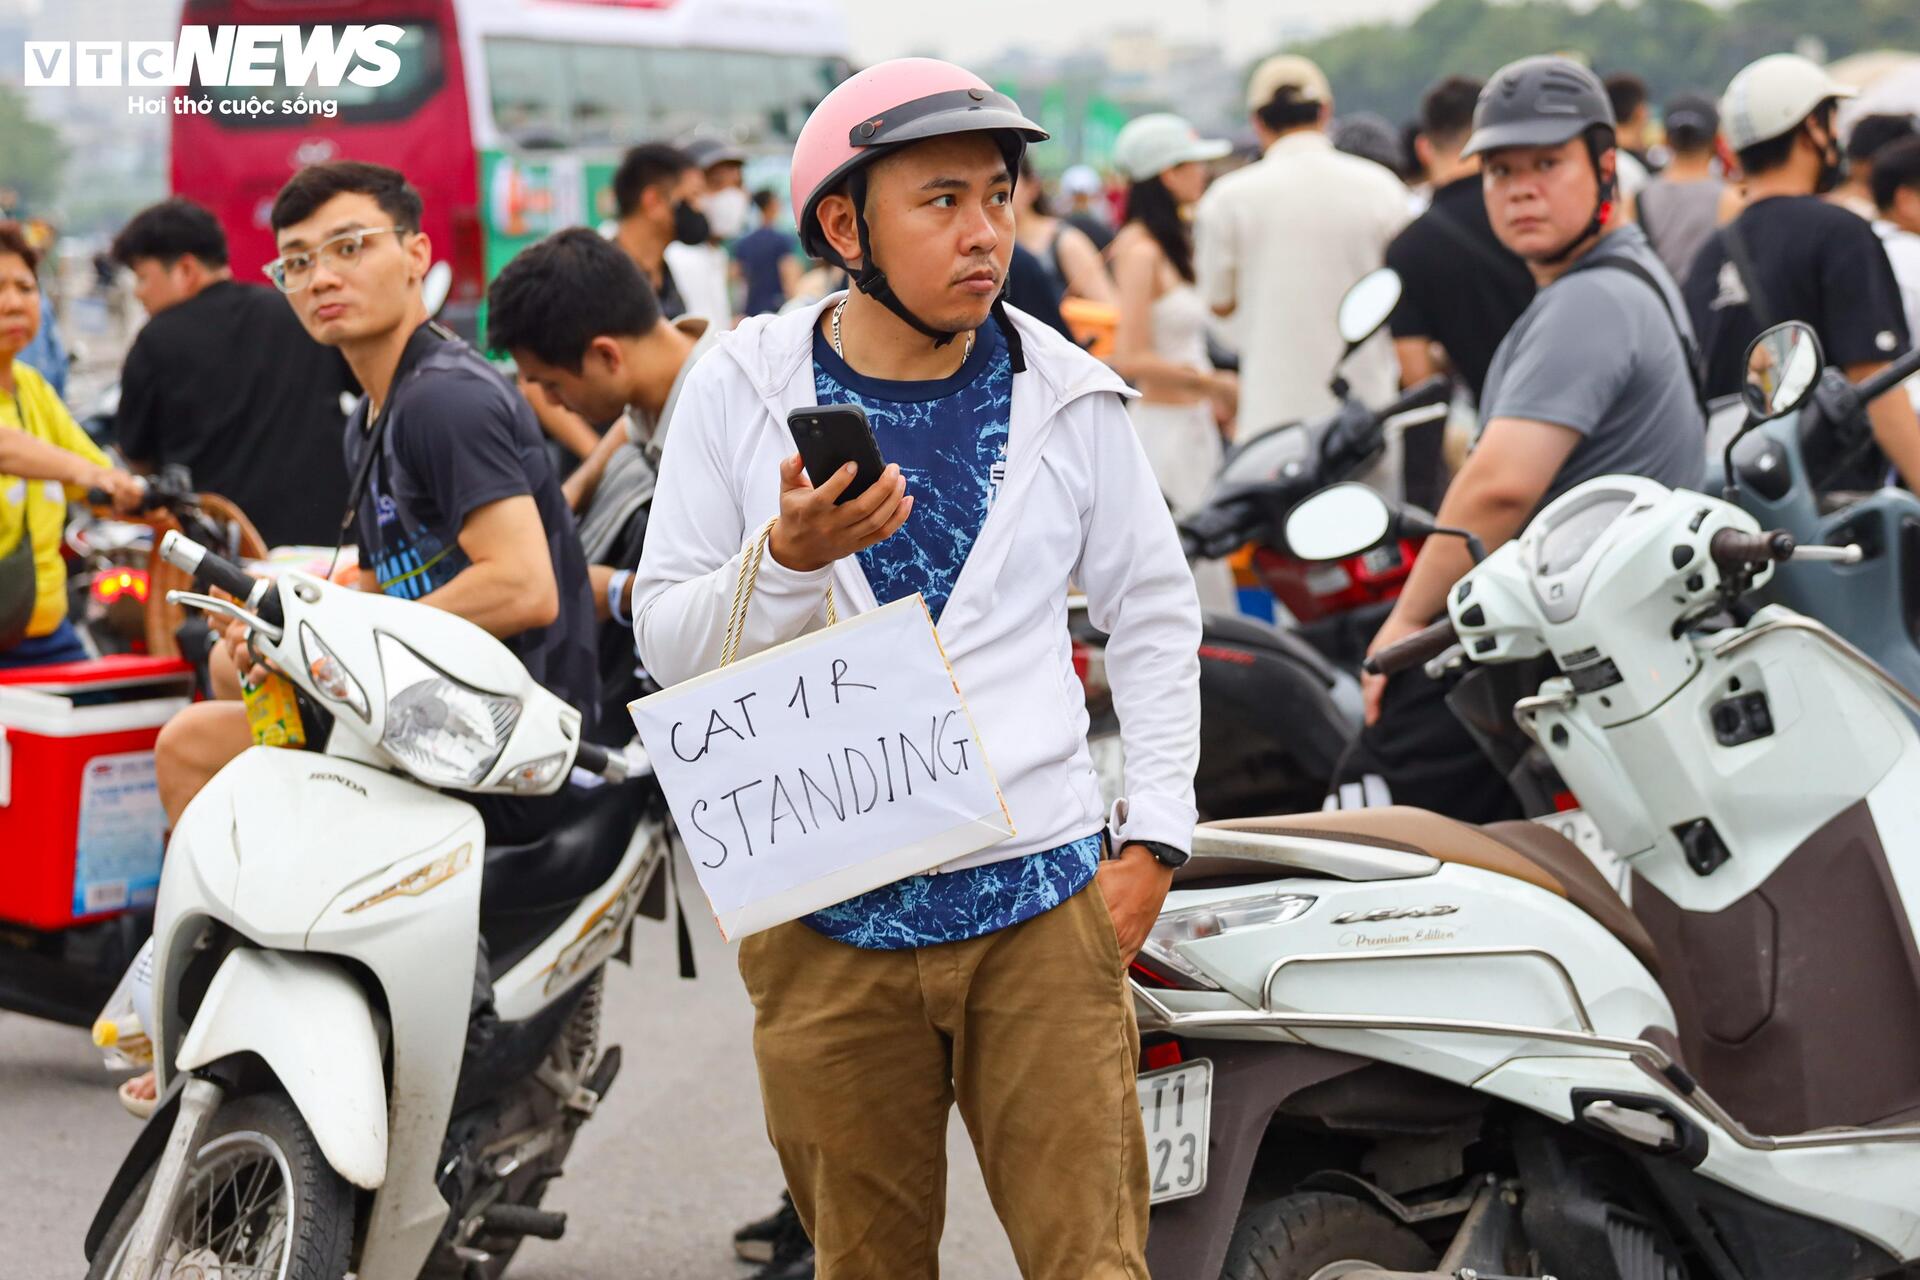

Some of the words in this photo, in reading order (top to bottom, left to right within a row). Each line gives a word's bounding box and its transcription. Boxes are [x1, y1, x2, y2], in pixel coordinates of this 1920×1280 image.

[671, 692, 757, 762] CAT
[309, 772, 368, 797] HONDA
[691, 710, 969, 869] STANDING
[1350, 932, 1410, 947] Premium
[1414, 928, 1456, 941] Edition
